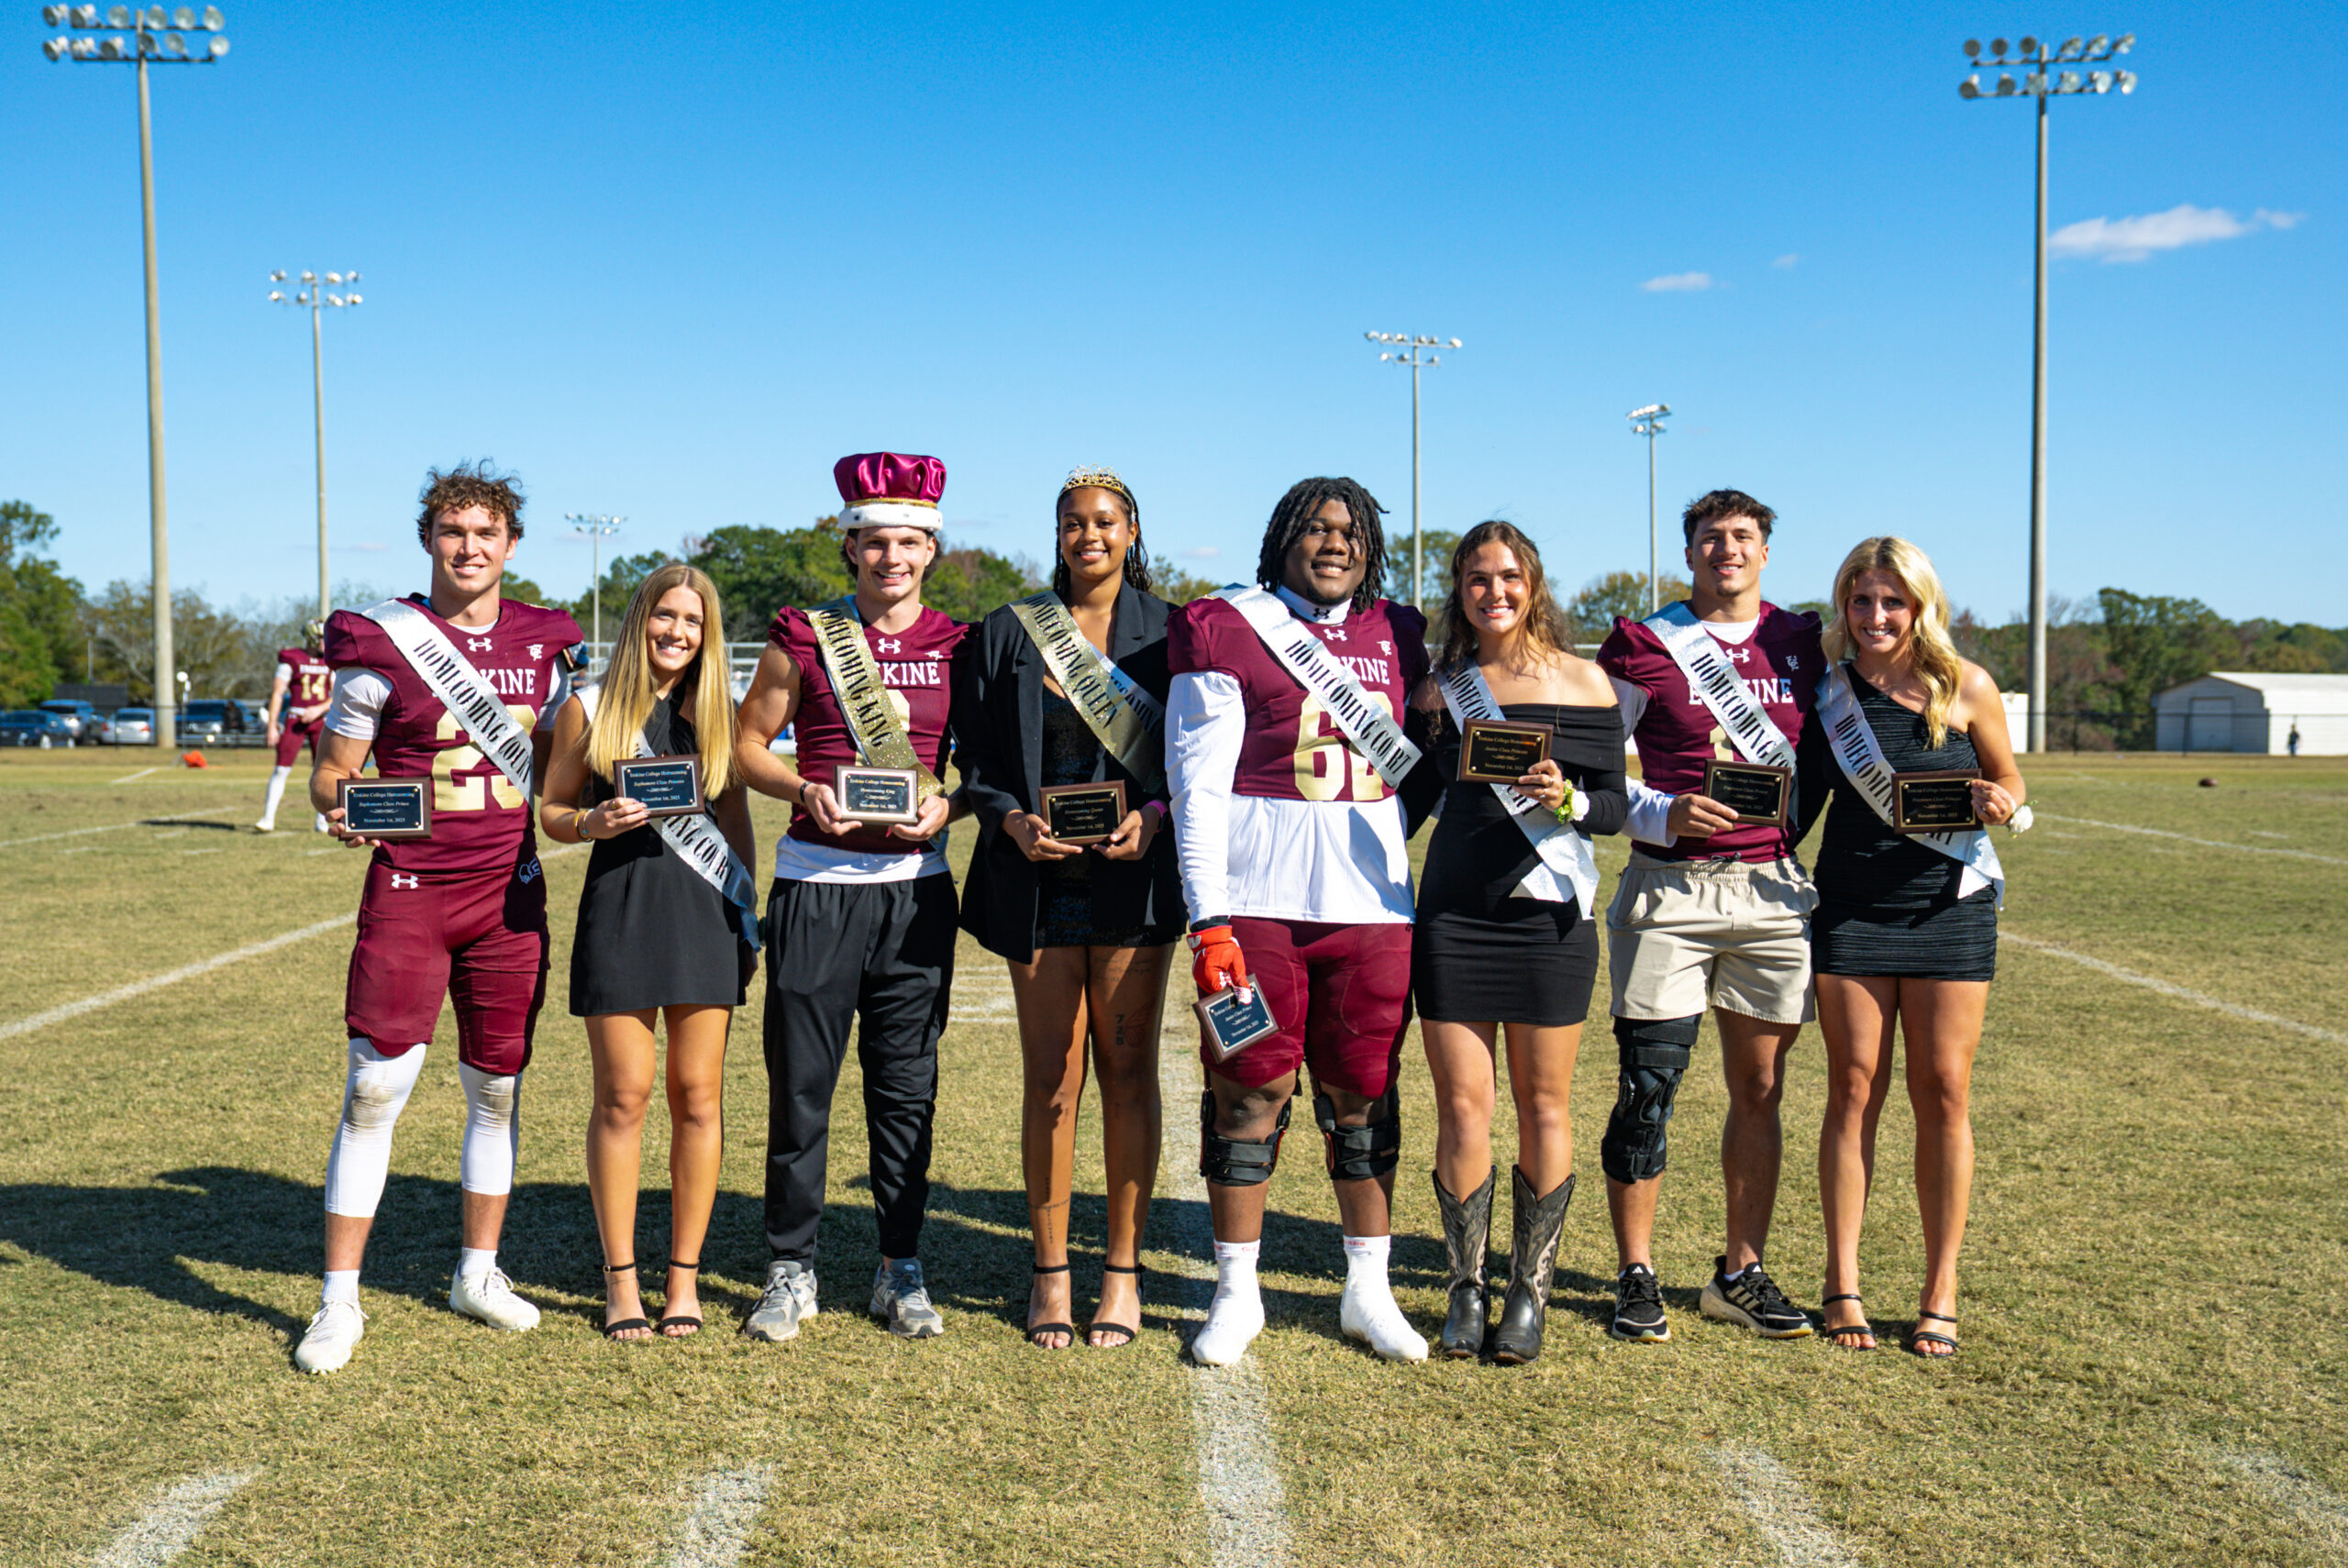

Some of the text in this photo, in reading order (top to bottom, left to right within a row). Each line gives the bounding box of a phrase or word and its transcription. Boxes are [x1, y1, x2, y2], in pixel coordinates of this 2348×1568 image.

[301, 674, 326, 701] 14
[414, 638, 508, 743] HOMECOMING
[479, 668, 536, 694] KINE
[819, 609, 873, 701] OMECOMING
[856, 700, 893, 747] KING
[881, 661, 940, 686] KINE
[1072, 675, 1119, 729] QUEEN
[1284, 639, 1379, 741] HOMECOMING
[1446, 668, 1491, 719] HOMECO
[1690, 652, 1778, 758] HOMECOMING
[1835, 712, 1893, 815] HOMECOMIN
